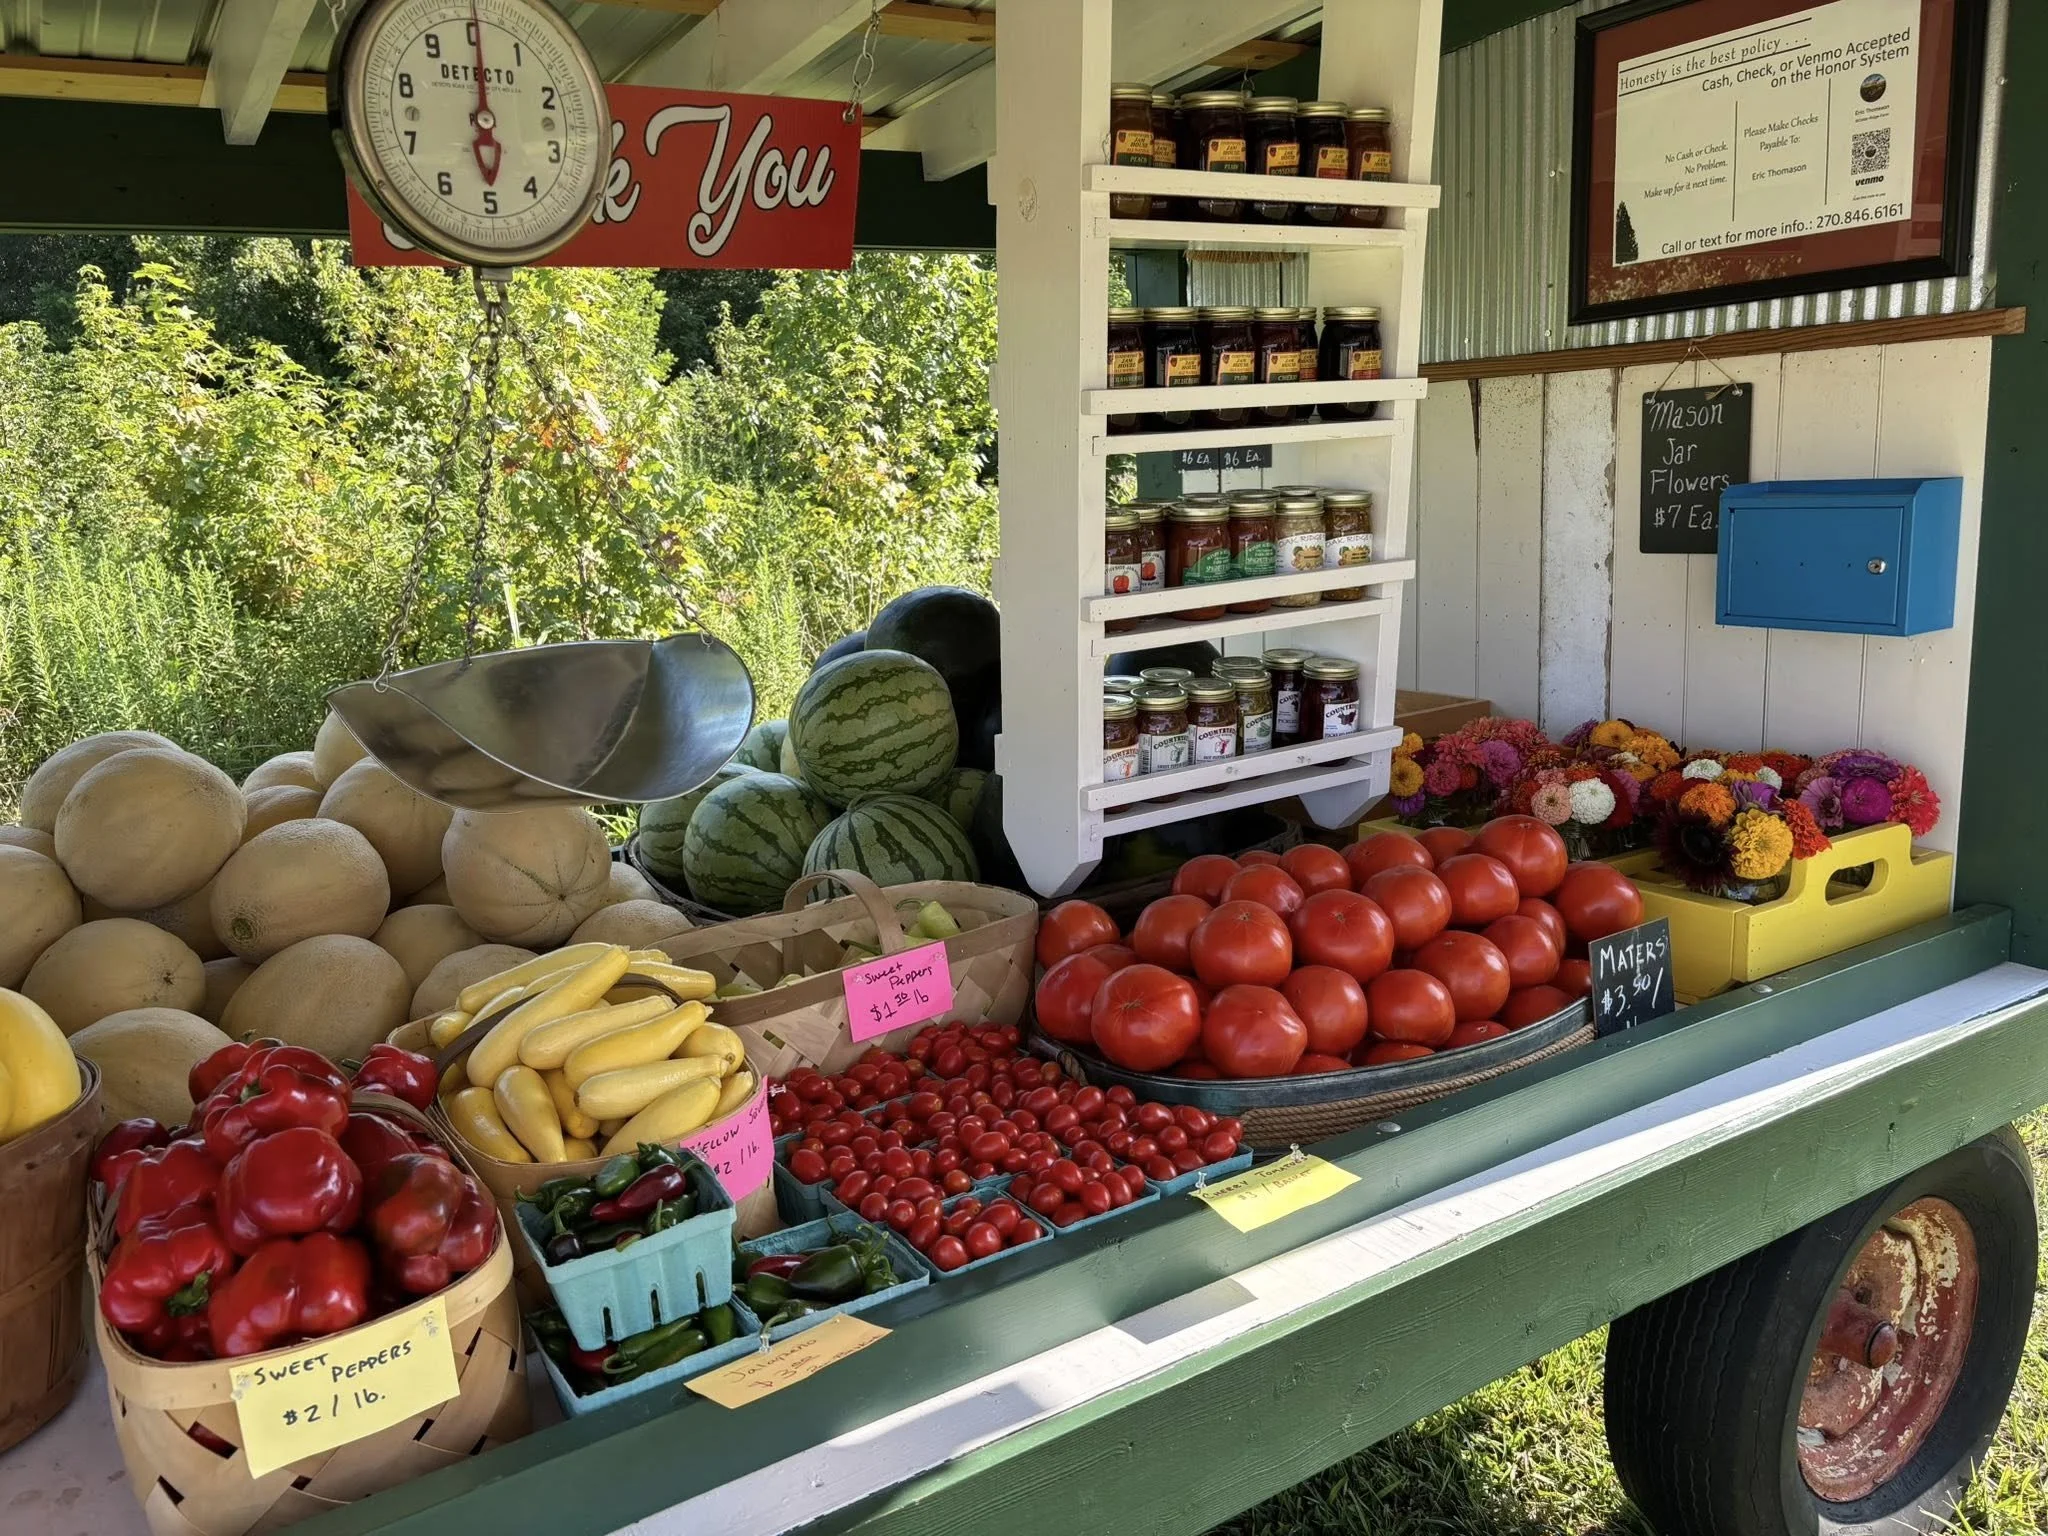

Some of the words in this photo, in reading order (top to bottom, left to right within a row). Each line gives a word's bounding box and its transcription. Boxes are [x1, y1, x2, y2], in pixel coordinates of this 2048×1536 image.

[425, 34, 441, 59] 9
[512, 43, 522, 67] 1
[1620, 67, 1667, 91] Honesty
[1672, 63, 1681, 77] is
[1686, 56, 1705, 74] the
[1710, 48, 1736, 66] best
[1741, 37, 1781, 62] policy
[1702, 76, 1733, 92] Cash,
[1736, 64, 1776, 84] Check,
[1780, 60, 1793, 72] or
[1797, 47, 1842, 67] Venmo
[1845, 27, 1911, 56] Accepted
[1771, 76, 1787, 88] on
[1790, 66, 1812, 84] the
[1815, 57, 1856, 78] Honor
[1859, 45, 1910, 69] System
[398, 73, 414, 98] 8
[440, 63, 515, 85] DETECTO
[541, 86, 556, 111] 2
[1744, 126, 1767, 138] Please
[1768, 119, 1789, 133] Make
[1790, 113, 1819, 128] Checks
[404, 131, 417, 155] 7
[547, 141, 561, 164] 3
[1664, 154, 1675, 164] No
[1676, 148, 1694, 161] Cash
[1695, 149, 1703, 157] or
[1704, 140, 1729, 155] Check.
[1759, 135, 1788, 152] Payable
[1789, 134, 1801, 144] To:
[1684, 165, 1695, 174] No
[1696, 159, 1728, 173] Problem.
[1752, 170, 1766, 181] Eric
[1768, 163, 1807, 178] Thomason
[437, 172, 453, 196] 6
[523, 176, 538, 199] 4
[644, 103, 836, 258] You
[1643, 187, 1662, 199] Make
[1663, 187, 1674, 197] up
[1672, 182, 1684, 196] for
[1685, 182, 1691, 190] it
[1692, 177, 1708, 189] next
[1709, 175, 1728, 185] time.
[1855, 175, 1885, 187] venmo
[483, 191, 498, 215] 5
[1661, 240, 1682, 256] Call
[1685, 237, 1696, 252] or
[1699, 234, 1722, 249] text
[1725, 230, 1743, 246] for
[1745, 225, 1778, 241] more
[1780, 219, 1813, 236] info.:
[1816, 202, 1905, 230] 270.846.6161
[1649, 399, 1724, 432] Mason
[1662, 438, 1698, 466] Jar
[1649, 469, 1730, 495] Flowers
[1653, 504, 1682, 529] $7
[1688, 504, 1719, 530] Ea.
[1278, 537, 1298, 549] OAK
[1325, 538, 1345, 548] OAK
[1600, 937, 1665, 979] MATERS
[864, 962, 903, 985] Sweet
[889, 966, 933, 990] Peppers
[1202, 1180, 1249, 1199] CHERRY
[253, 1352, 329, 1386] SWEET
[331, 1340, 412, 1384] PEPPERS
[354, 1387, 387, 1410] lb.
